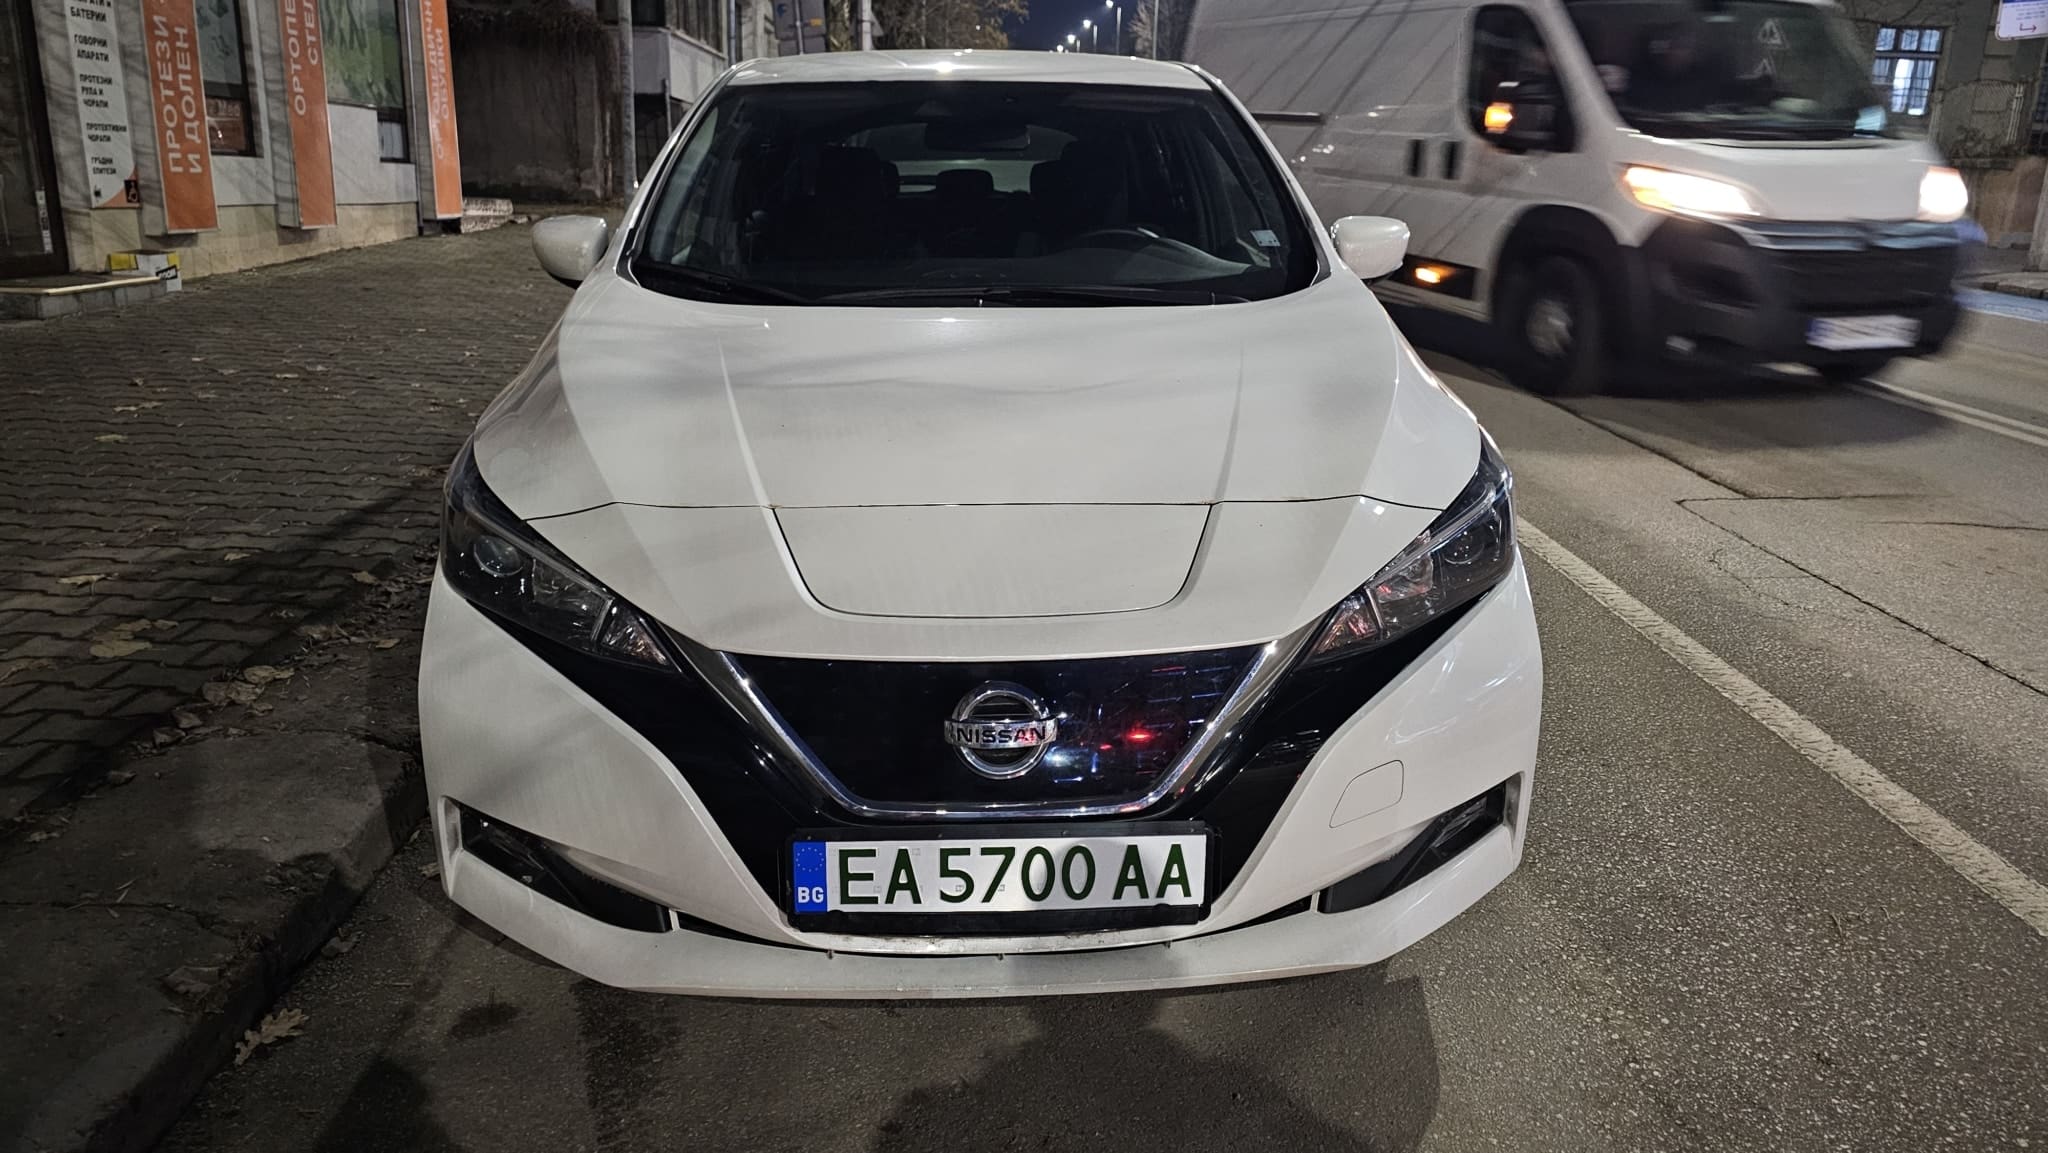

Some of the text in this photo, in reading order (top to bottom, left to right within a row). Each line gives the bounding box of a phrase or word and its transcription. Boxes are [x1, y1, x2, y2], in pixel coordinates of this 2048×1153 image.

[70, 6, 107, 23] БАТЕРИИ
[74, 34, 108, 48] ГОВОРНИ
[77, 48, 110, 62] АПАРАТИ
[285, 0, 307, 116] ОРТОПЕ
[79, 73, 113, 86] ПРОТЕЗНИ
[434, 28, 450, 120] ОБУВКИ
[153, 15, 184, 174] ПРОТЕЗИ
[174, 26, 203, 174] И ДОЛЕН
[83, 98, 109, 109] ЧОРАПИ
[86, 122, 127, 133] ПРОТЕКТИВНИ
[87, 134, 112, 142] ЧОРАПИ
[956, 727, 1047, 745] NISSAN
[838, 843, 1192, 905] EA 5700 AA
[797, 886, 825, 904] BG
